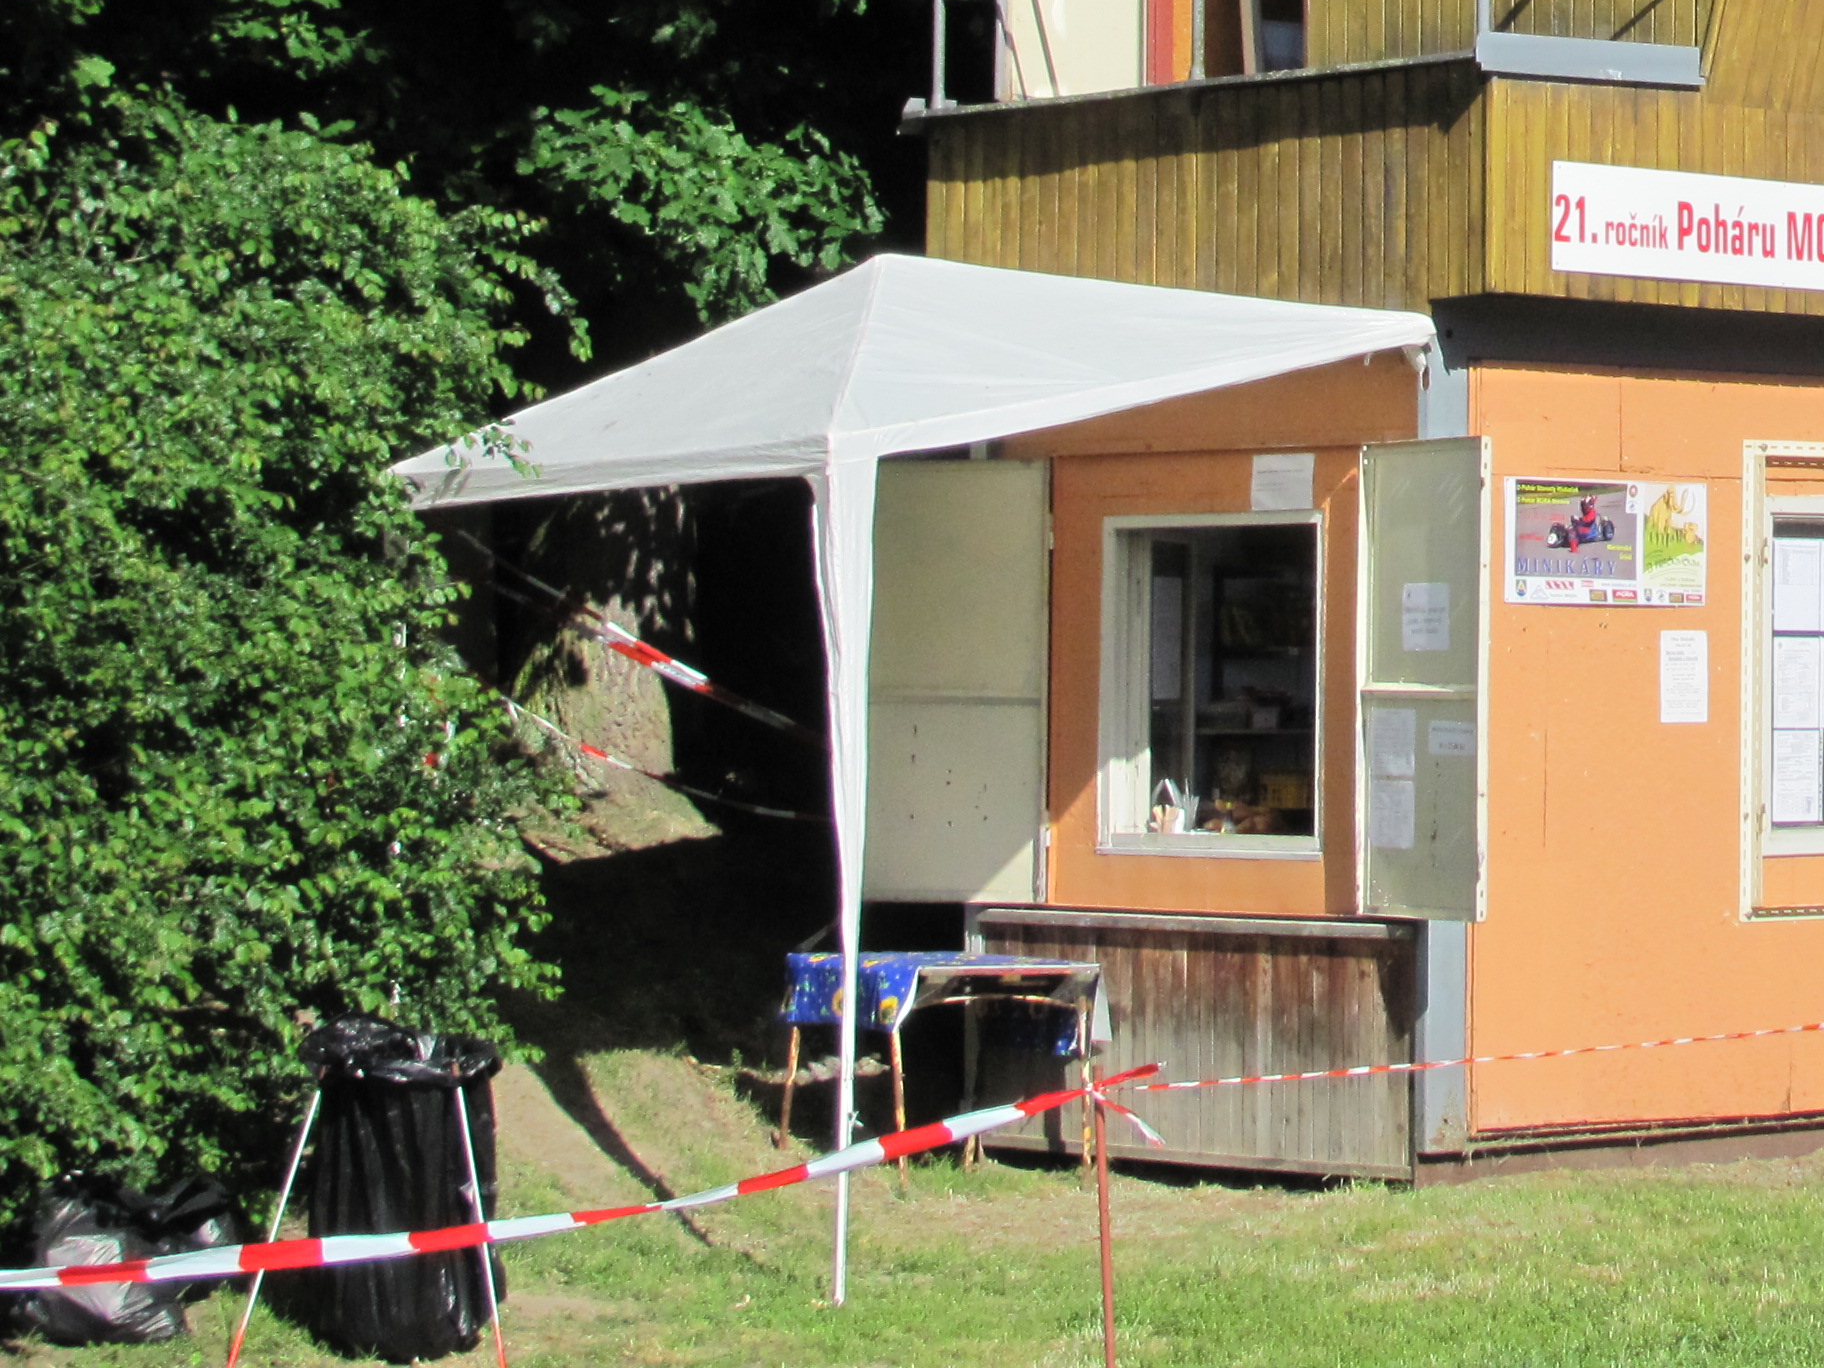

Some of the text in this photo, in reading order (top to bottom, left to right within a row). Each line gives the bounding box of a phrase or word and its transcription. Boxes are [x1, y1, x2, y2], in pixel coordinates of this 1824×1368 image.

[1553, 194, 1599, 245] 21.
[1604, 211, 1669, 250] ročník
[1677, 201, 1776, 259] Poháru
[1517, 555, 1617, 575] MINIKÁRY
